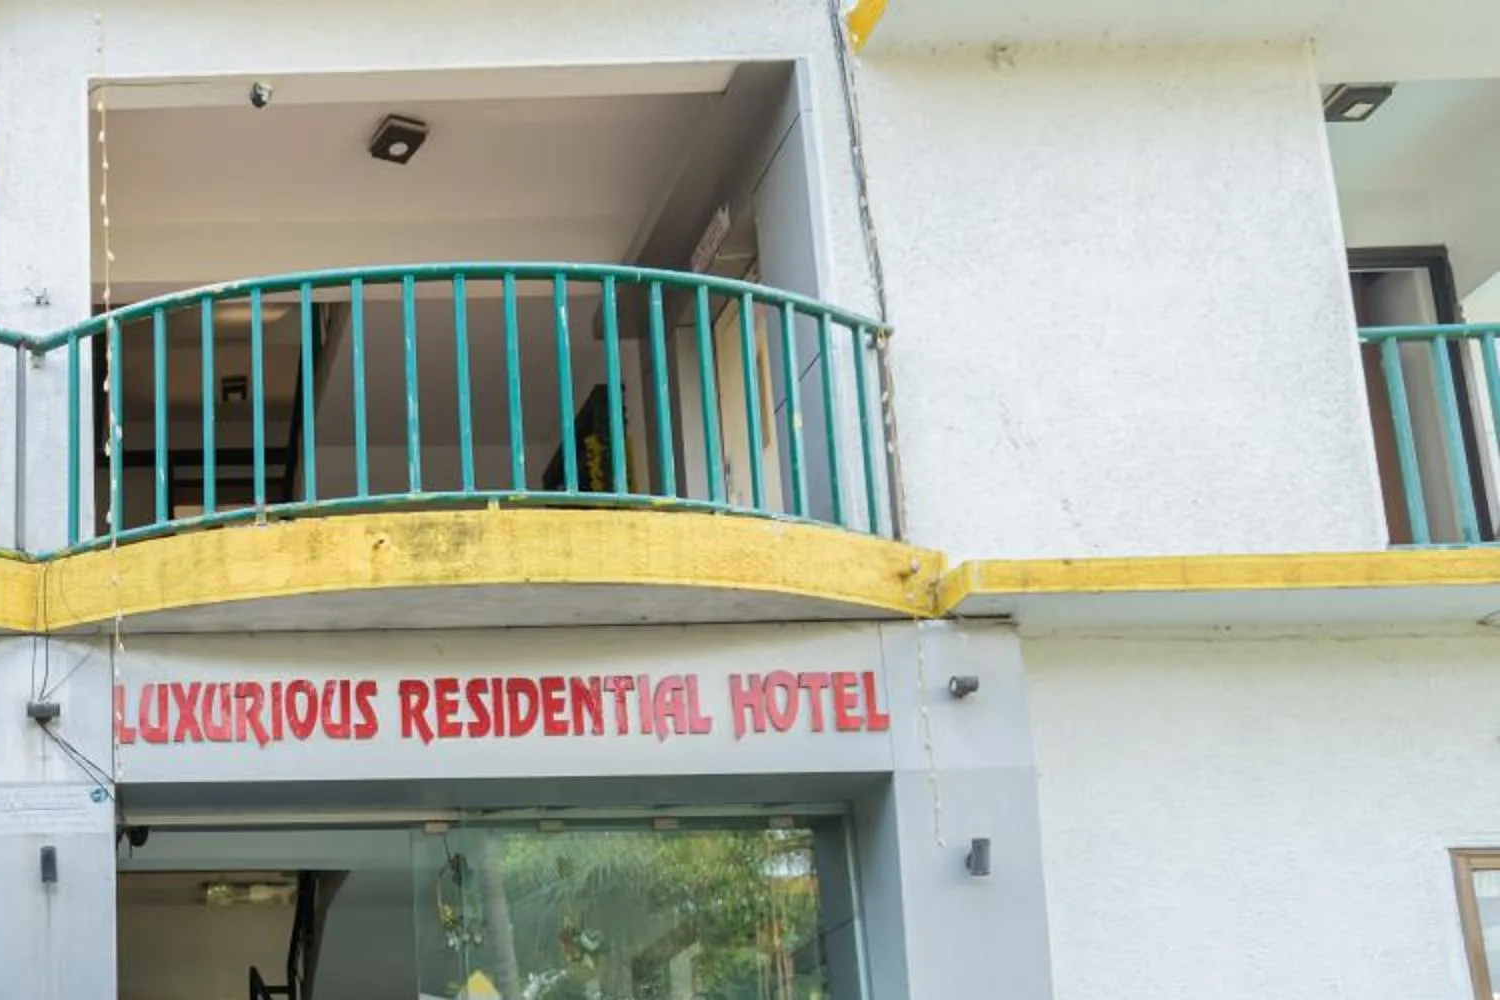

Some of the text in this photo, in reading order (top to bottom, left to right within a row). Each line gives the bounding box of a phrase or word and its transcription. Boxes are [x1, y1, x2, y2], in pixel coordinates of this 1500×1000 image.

[114, 669, 891, 748] LUXURIOUS RESIDENTIAL HOTEL
